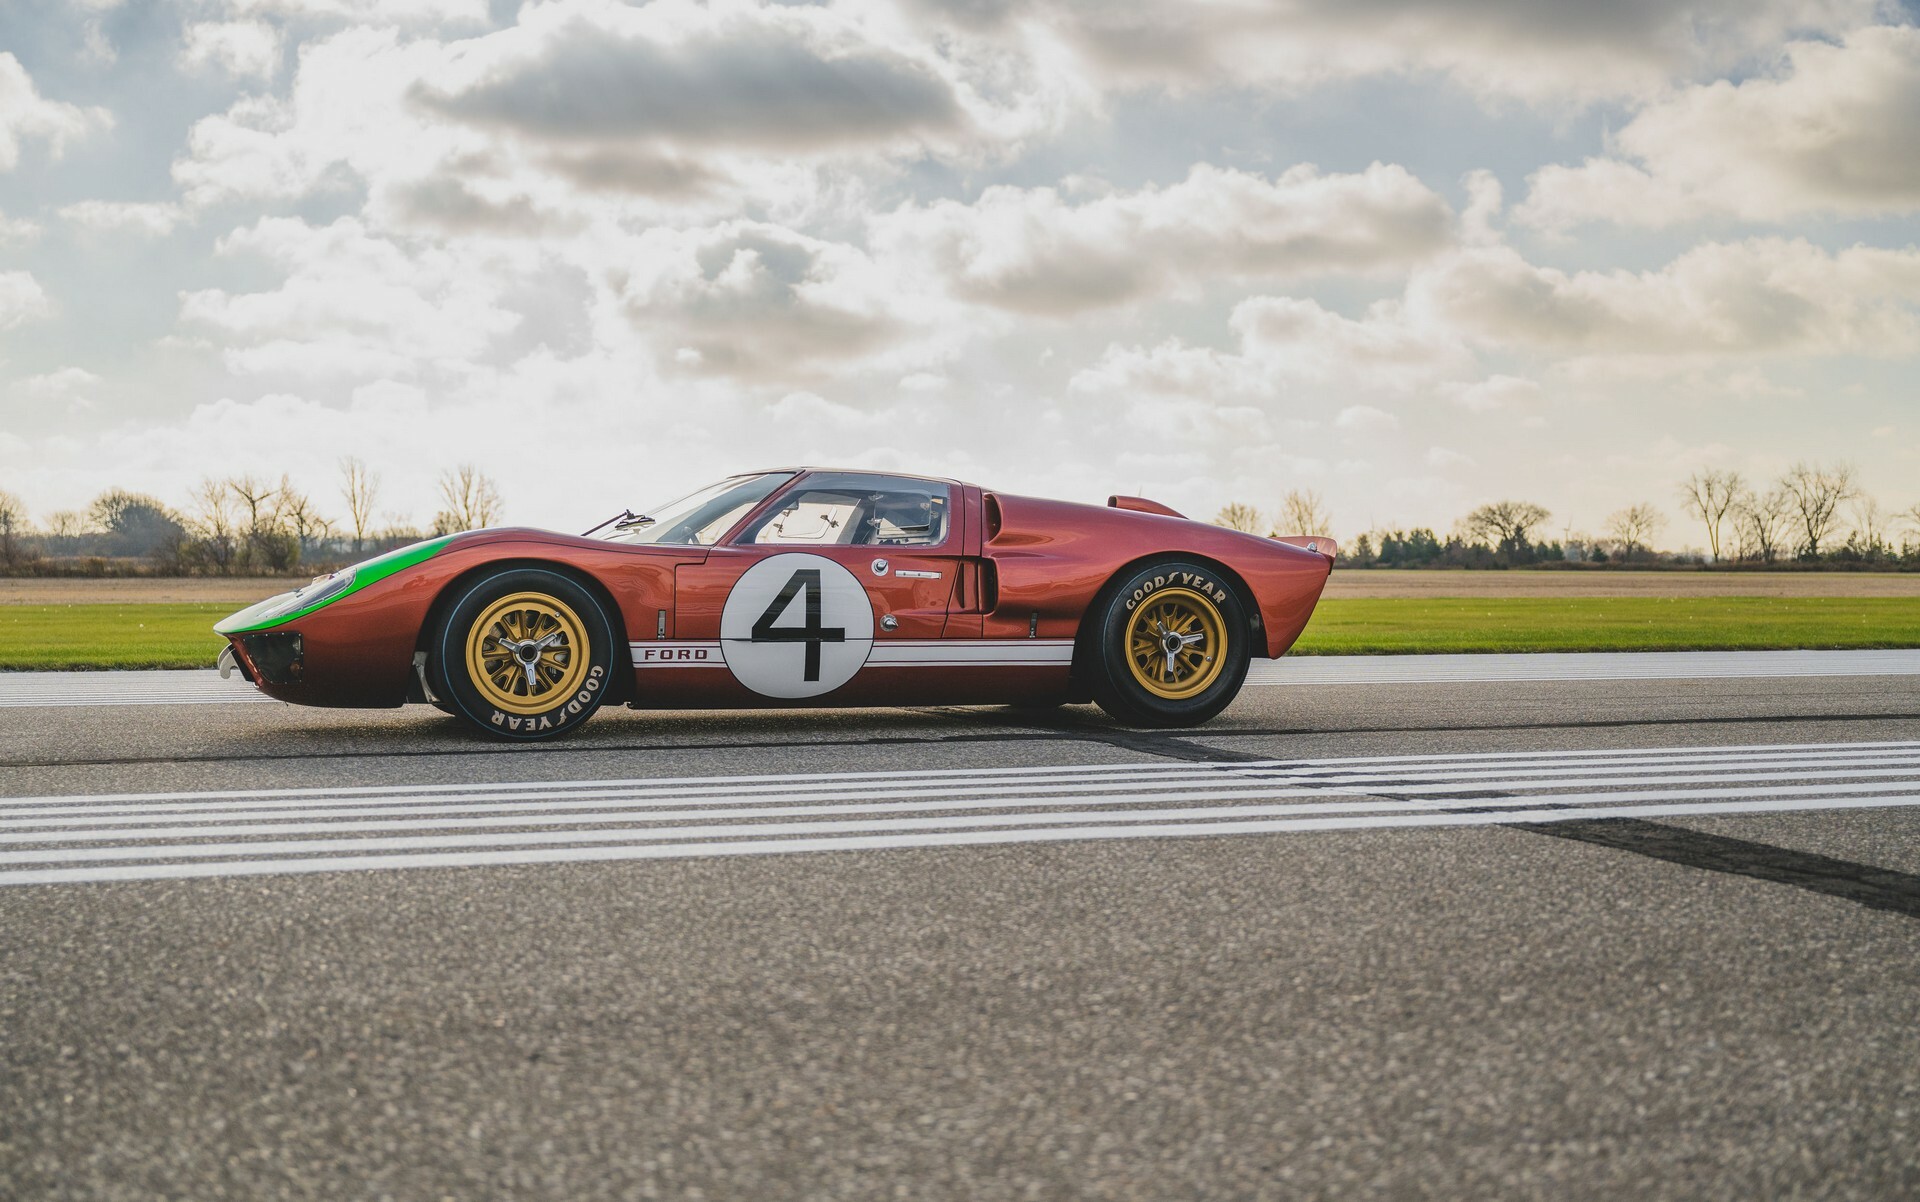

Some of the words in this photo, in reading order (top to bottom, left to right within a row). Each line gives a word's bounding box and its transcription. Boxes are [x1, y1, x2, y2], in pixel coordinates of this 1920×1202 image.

[1125, 571, 1227, 610] GOODYEAR
[751, 569, 845, 682] 4
[644, 649, 708, 660] FORD
